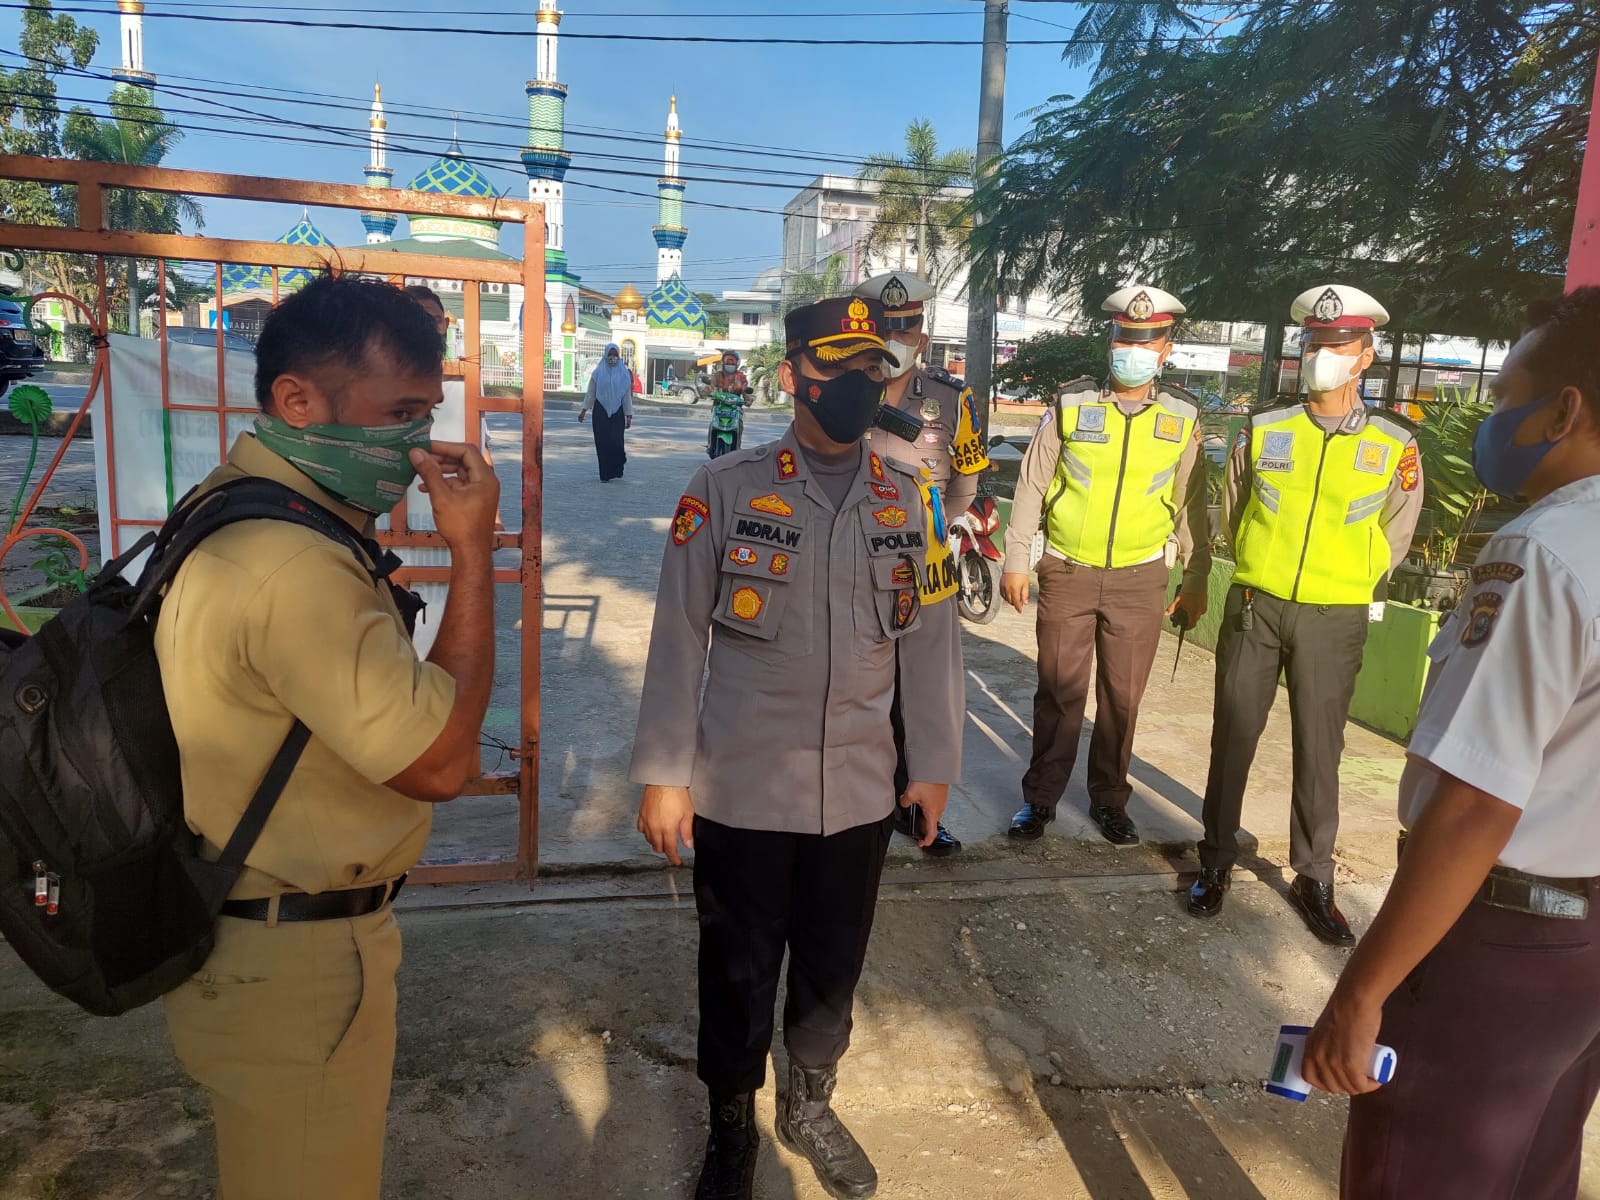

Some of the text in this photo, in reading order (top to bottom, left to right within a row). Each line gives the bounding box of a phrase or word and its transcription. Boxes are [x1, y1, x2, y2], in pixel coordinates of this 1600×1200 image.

[1261, 461, 1289, 469] POLRI
[682, 497, 708, 514] PROPAM
[736, 519, 800, 547] INDRA.W
[871, 532, 923, 552] POLRI
